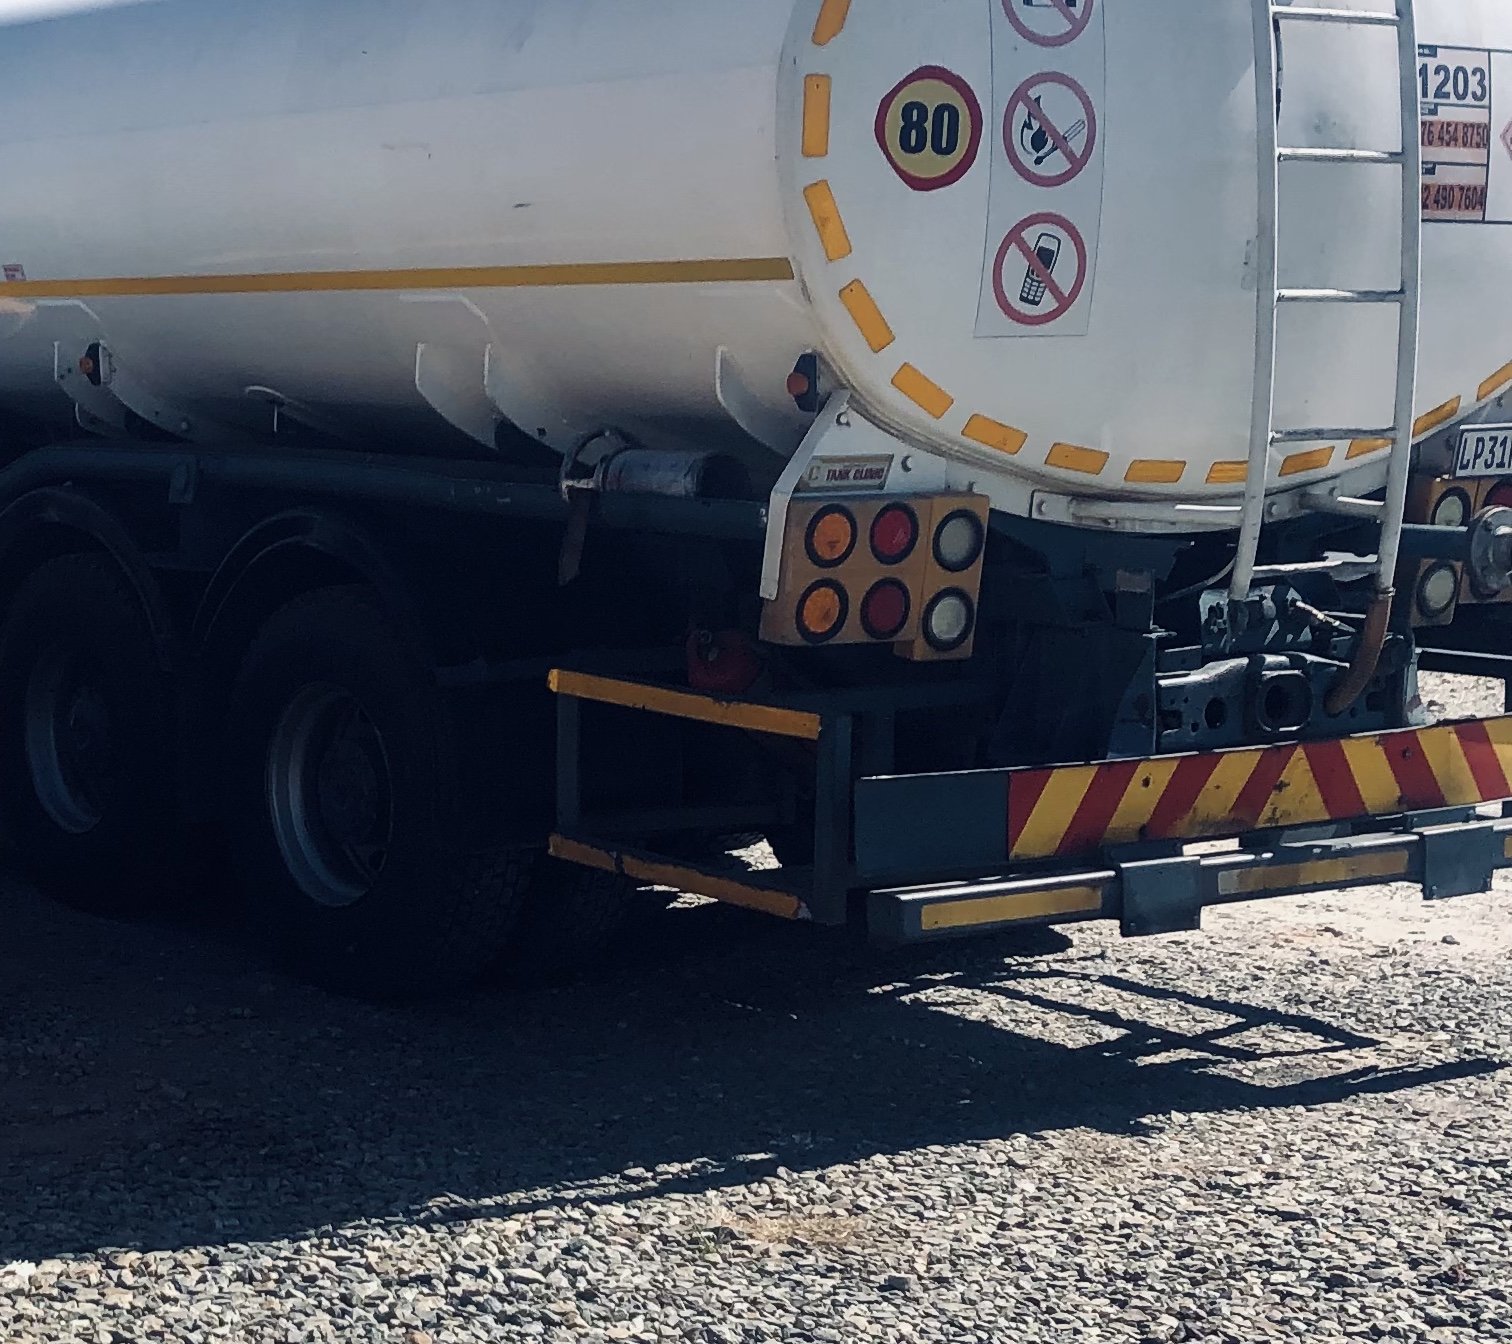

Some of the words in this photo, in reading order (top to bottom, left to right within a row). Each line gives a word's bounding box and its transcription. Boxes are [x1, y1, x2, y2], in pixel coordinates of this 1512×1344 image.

[1419, 63, 1487, 102] 1203
[899, 101, 959, 156] 80
[1437, 121, 1459, 147] 454
[1459, 435, 1512, 470] LP31
